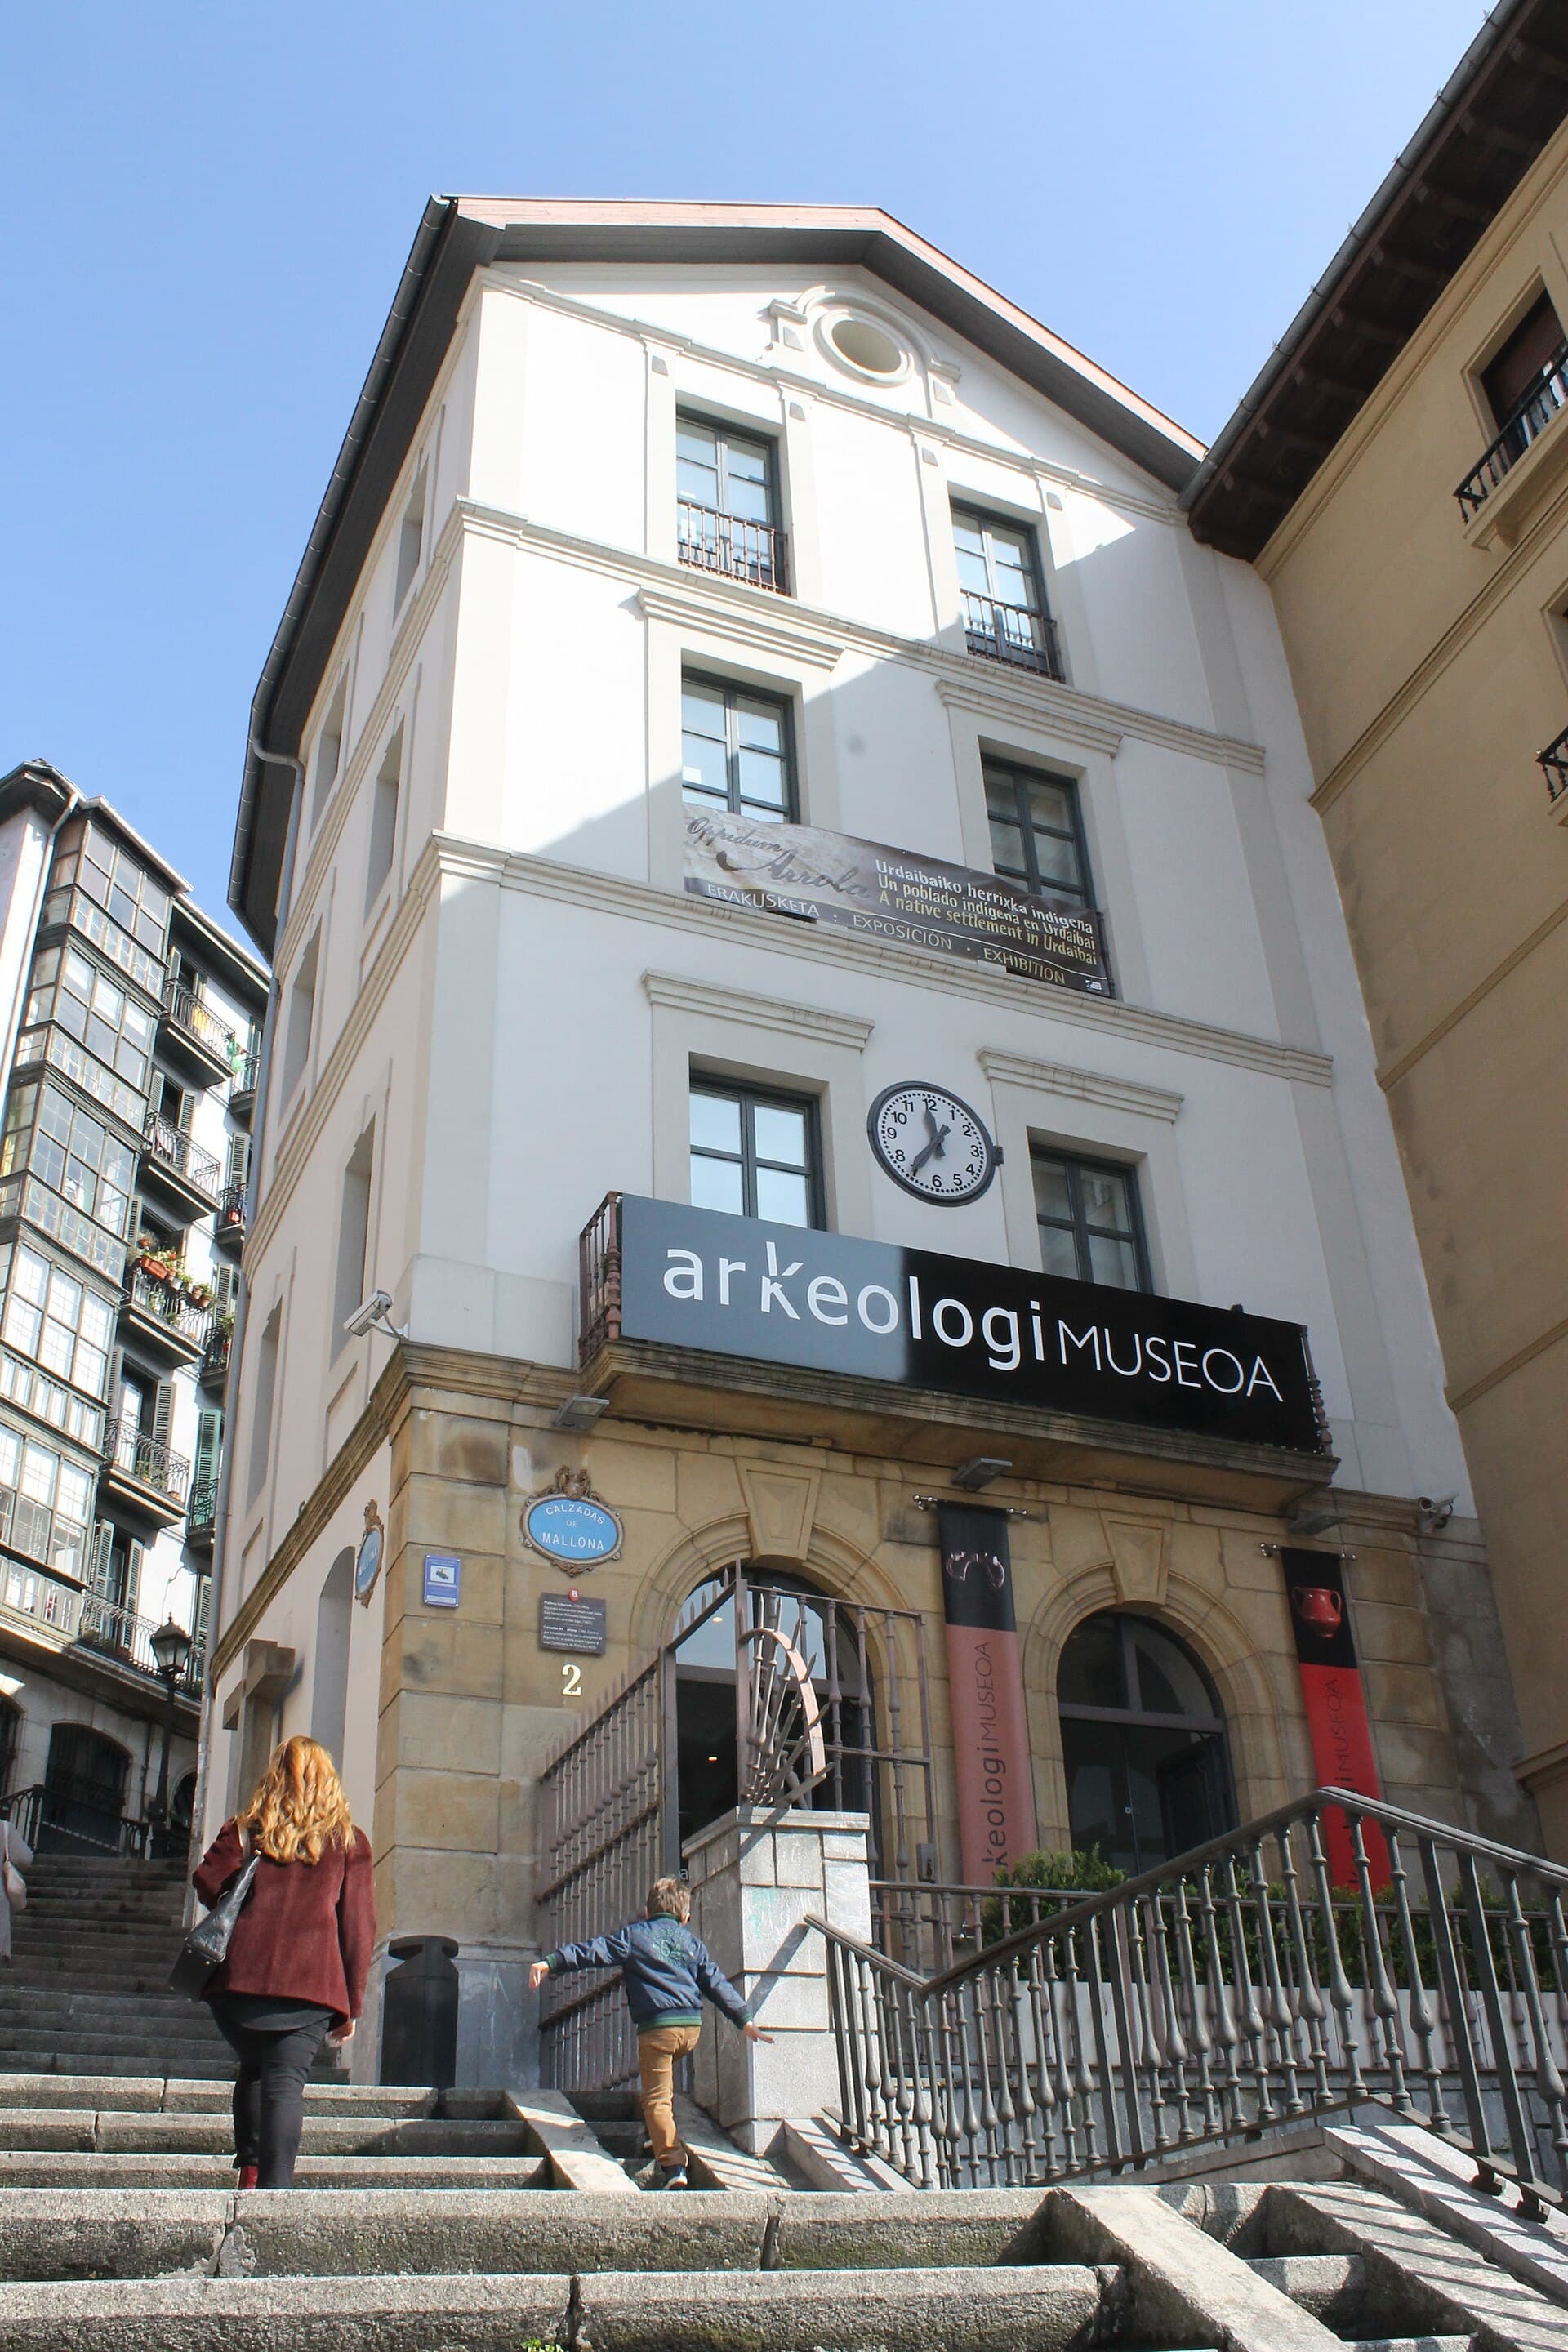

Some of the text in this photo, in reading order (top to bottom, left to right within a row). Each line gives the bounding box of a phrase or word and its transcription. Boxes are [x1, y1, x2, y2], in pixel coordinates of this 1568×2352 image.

[687, 817, 783, 852] Oppidum
[716, 849, 872, 898] Arrola
[875, 859, 962, 894] Urdaibaiko
[967, 883, 1028, 915] herrixka
[878, 874, 898, 891] Un
[902, 881, 958, 908] poblado
[1023, 918, 1040, 932] en
[1042, 921, 1095, 951] Urdaibai
[879, 890, 1098, 966] A native settlement in Urdaibai
[707, 884, 1067, 986] ERAKUSKETA EXPOSICIÓN EXHIBITION
[902, 1100, 915, 1112] 11
[922, 1098, 938, 1111] 12
[891, 1111, 907, 1125] 10
[949, 1110, 956, 1120] 1
[887, 1127, 897, 1139] 9
[962, 1125, 972, 1137] 2
[895, 1149, 906, 1162] 8
[970, 1144, 980, 1157] 3
[965, 1164, 976, 1176] 4
[932, 1174, 942, 1187] 6
[953, 1174, 963, 1187] 5
[546, 1504, 605, 1524] CALZADAS
[566, 1520, 578, 1528] DE
[542, 1531, 604, 1552] MALLONA
[562, 1664, 582, 1697] 2
